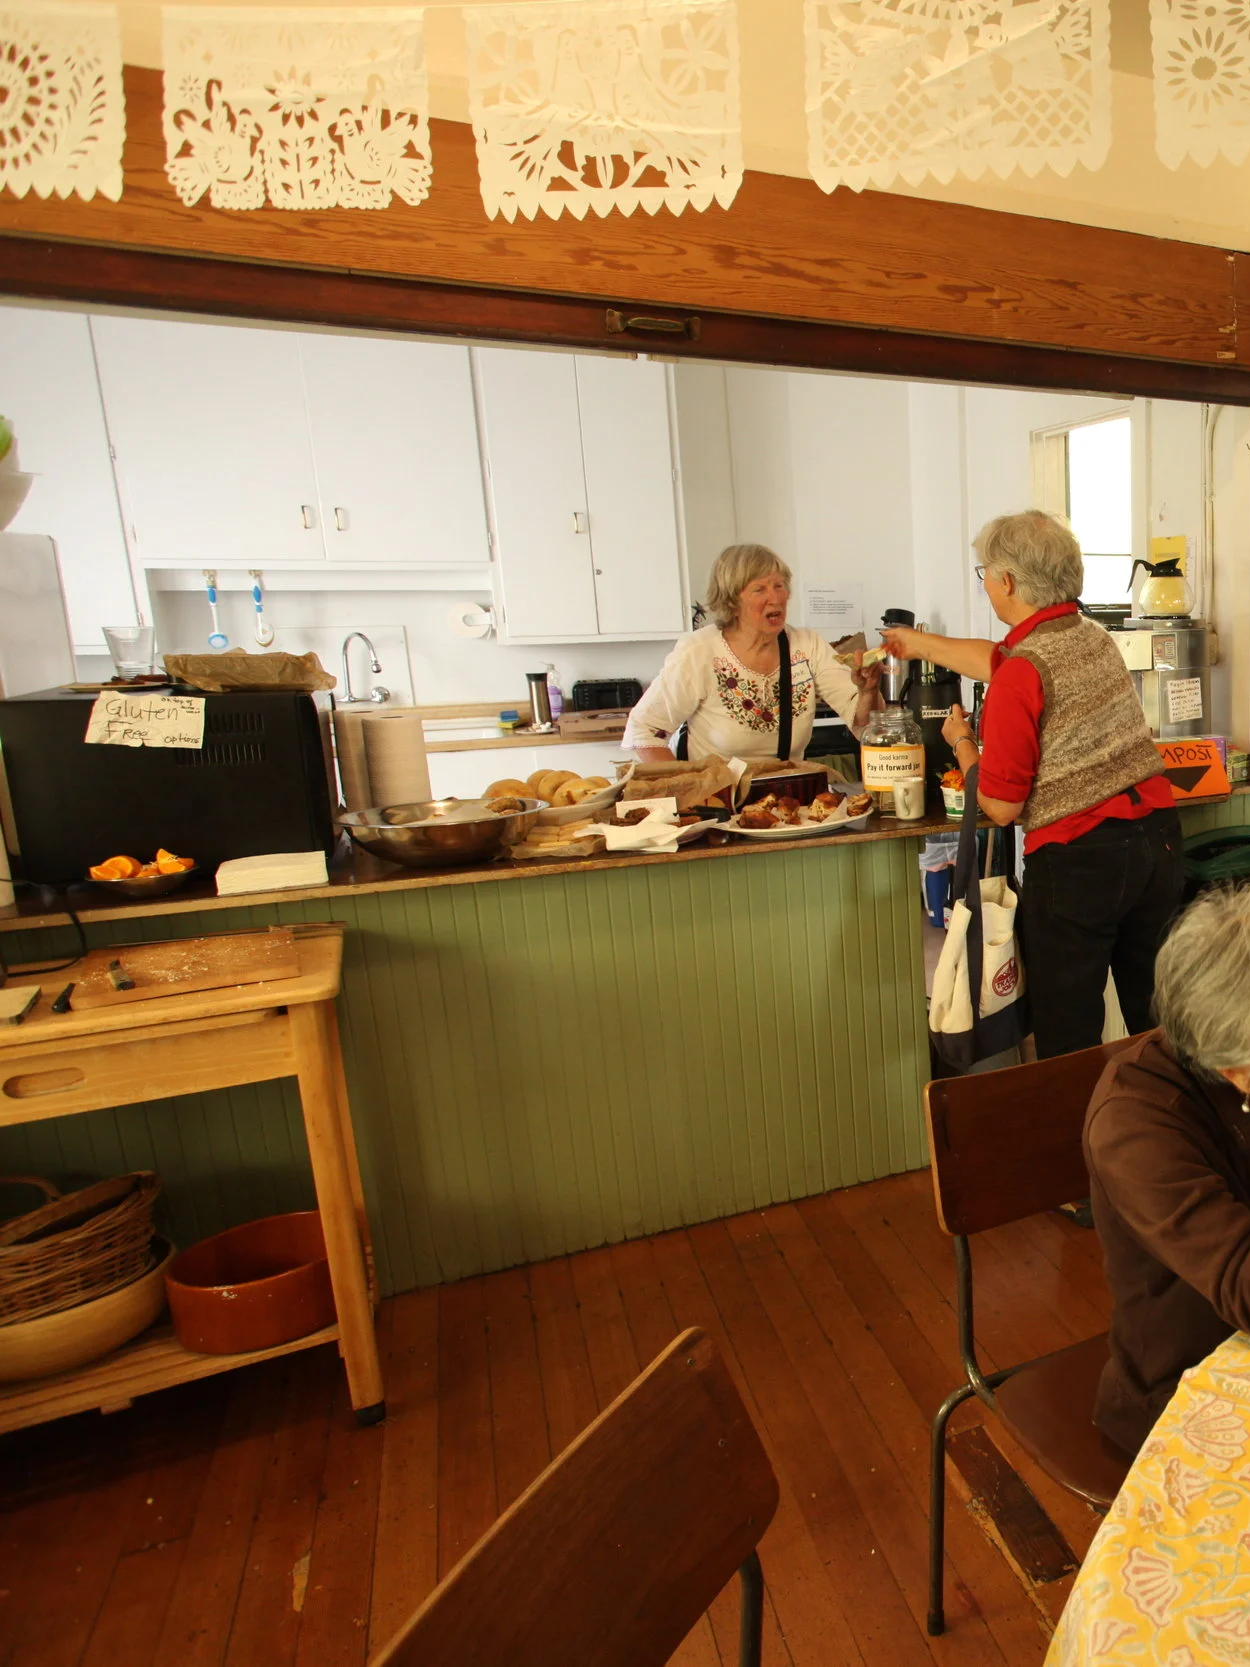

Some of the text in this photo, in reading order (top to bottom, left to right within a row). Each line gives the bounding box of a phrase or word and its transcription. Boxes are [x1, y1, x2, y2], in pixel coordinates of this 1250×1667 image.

[105, 699, 179, 722] Gluten
[1161, 744, 1212, 764] MPOST
[867, 763, 877, 772] Pay
[886, 763, 912, 771] forward
